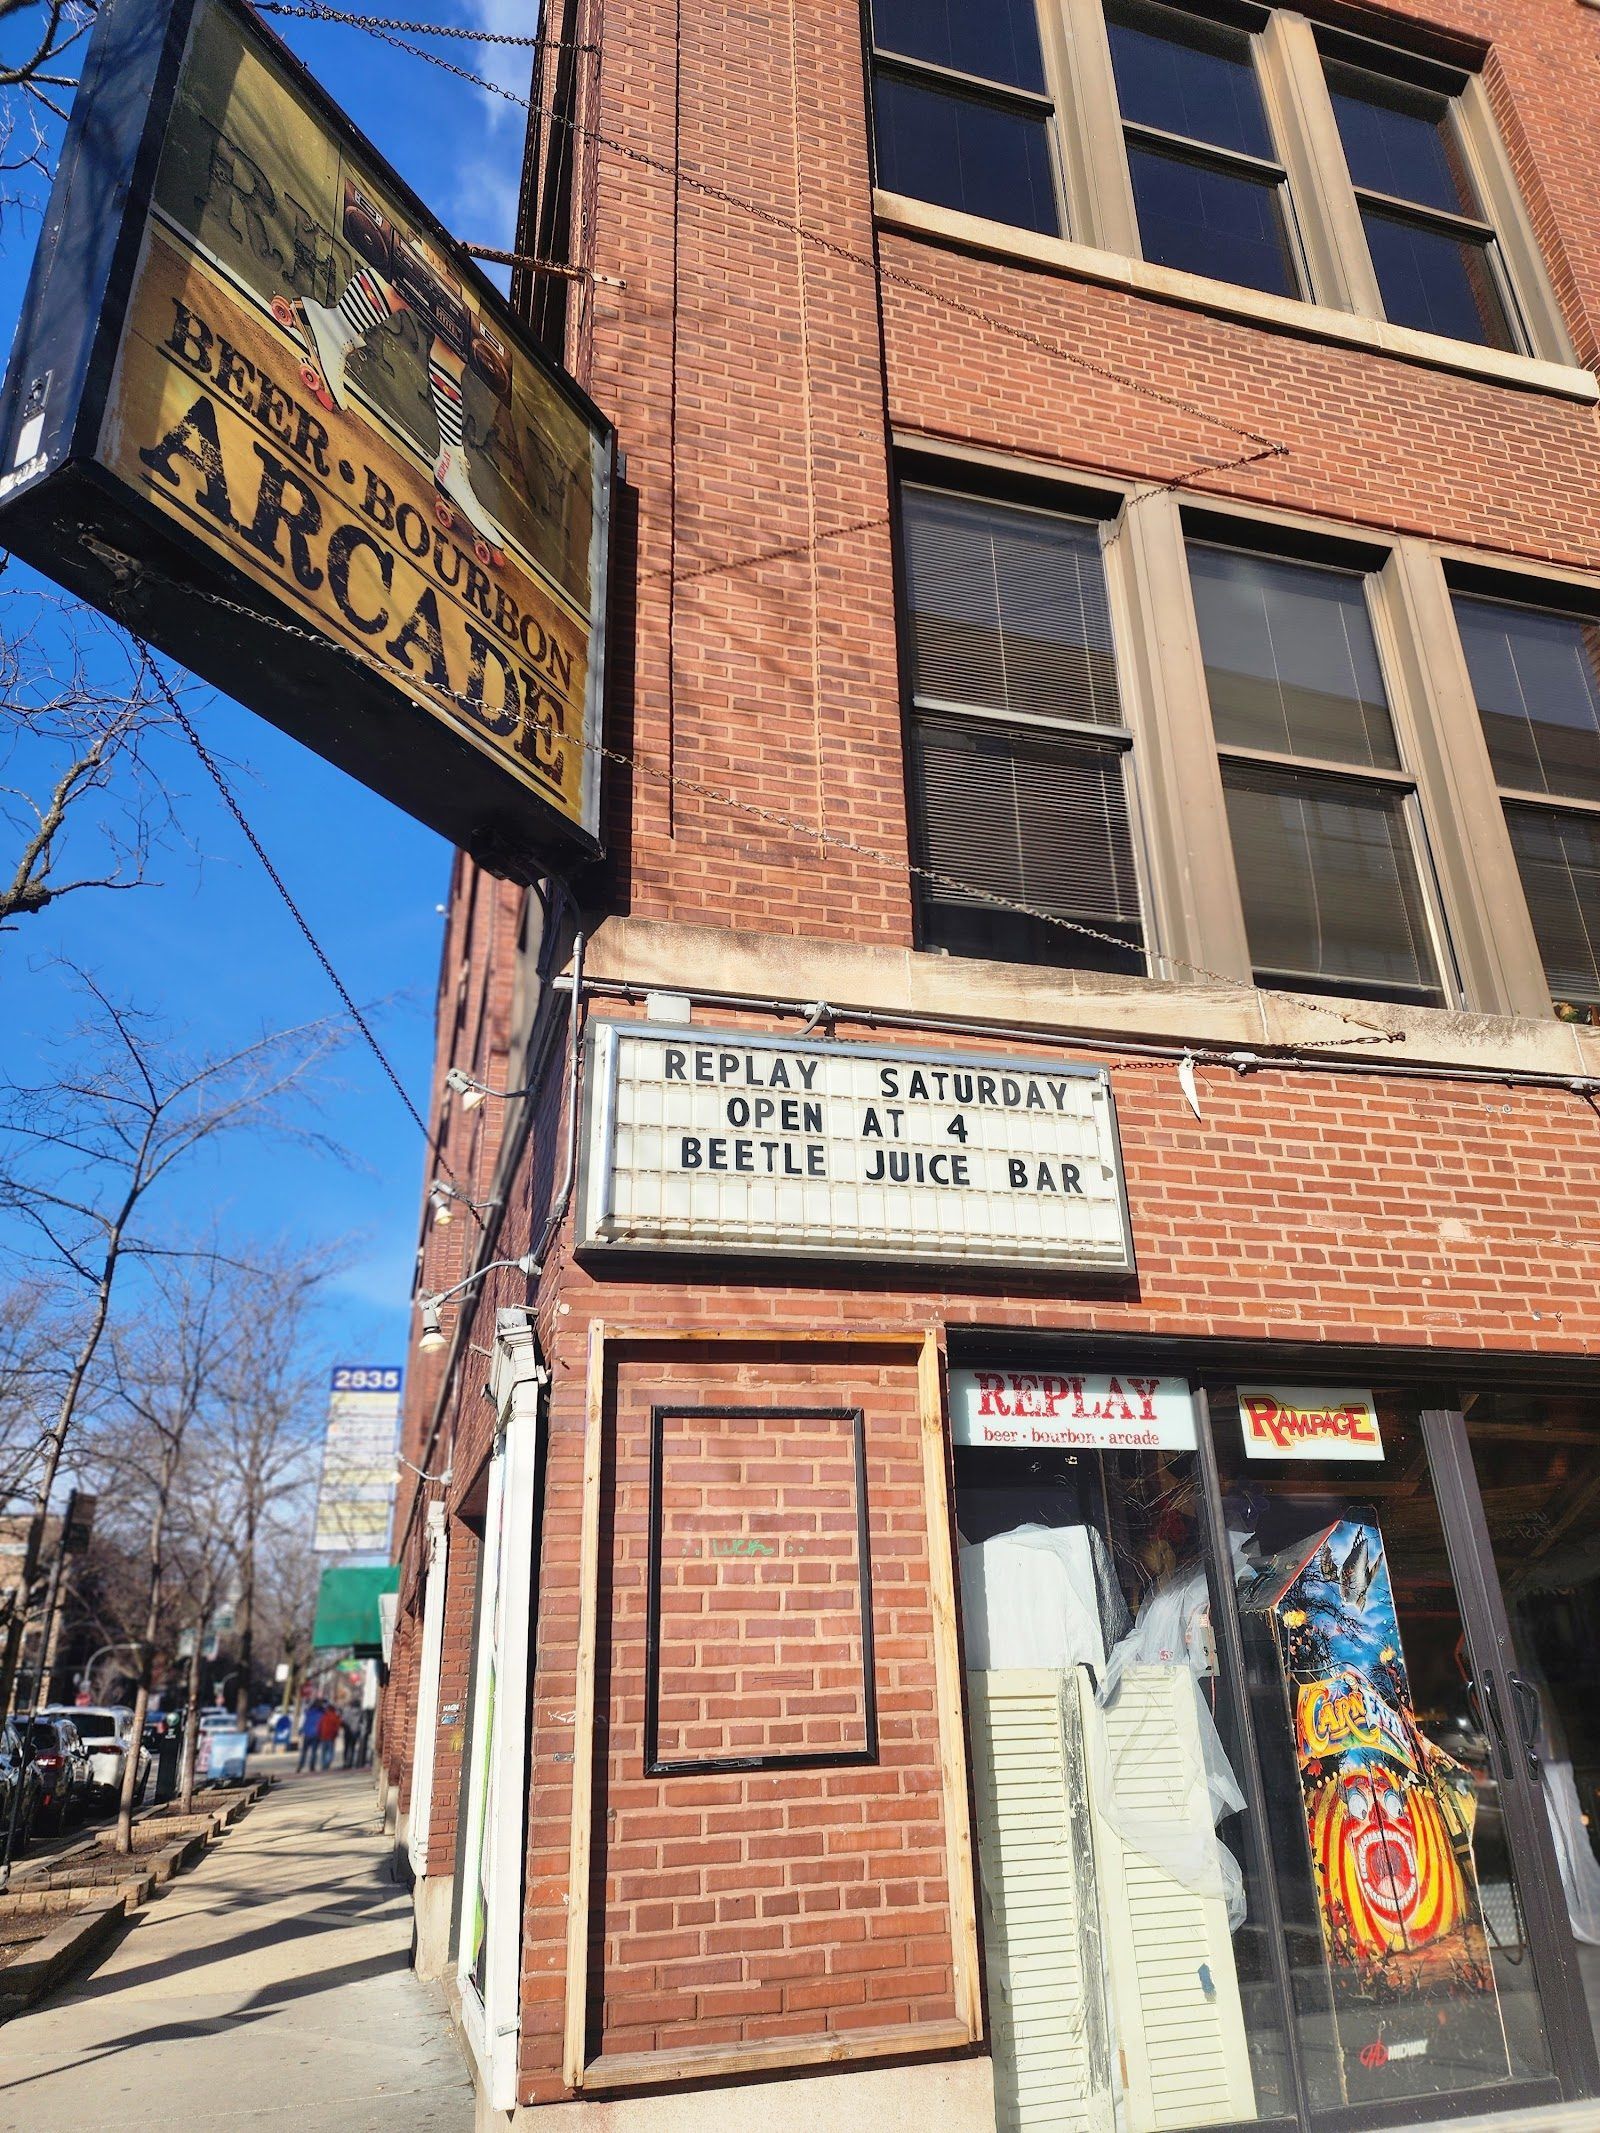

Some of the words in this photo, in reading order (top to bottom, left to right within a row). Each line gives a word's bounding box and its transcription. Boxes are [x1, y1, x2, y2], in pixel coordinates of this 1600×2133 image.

[198, 114, 578, 544] REPAY
[164, 297, 332, 478] BEER
[360, 469, 576, 692] BOURBON
[139, 395, 566, 789] ARCADE
[665, 1049, 818, 1090] REPLAY
[880, 1067, 1068, 1112] SATURDAY
[727, 1096, 823, 1133] OPEN
[862, 1107, 905, 1138] AT
[947, 1114, 968, 1143] 4
[681, 1136, 827, 1176] BEETLE
[865, 1149, 971, 1186] JUICE
[1009, 1158, 1083, 1194] BAR
[974, 1371, 1160, 1421] REPLAY
[1242, 1395, 1377, 1448] RAMPAGE
[983, 1425, 1018, 1443] beer
[1031, 1426, 1098, 1444] bourbon
[1109, 1429, 1160, 1446] arcade
[1387, 2038, 1429, 2061] MIDWAY
